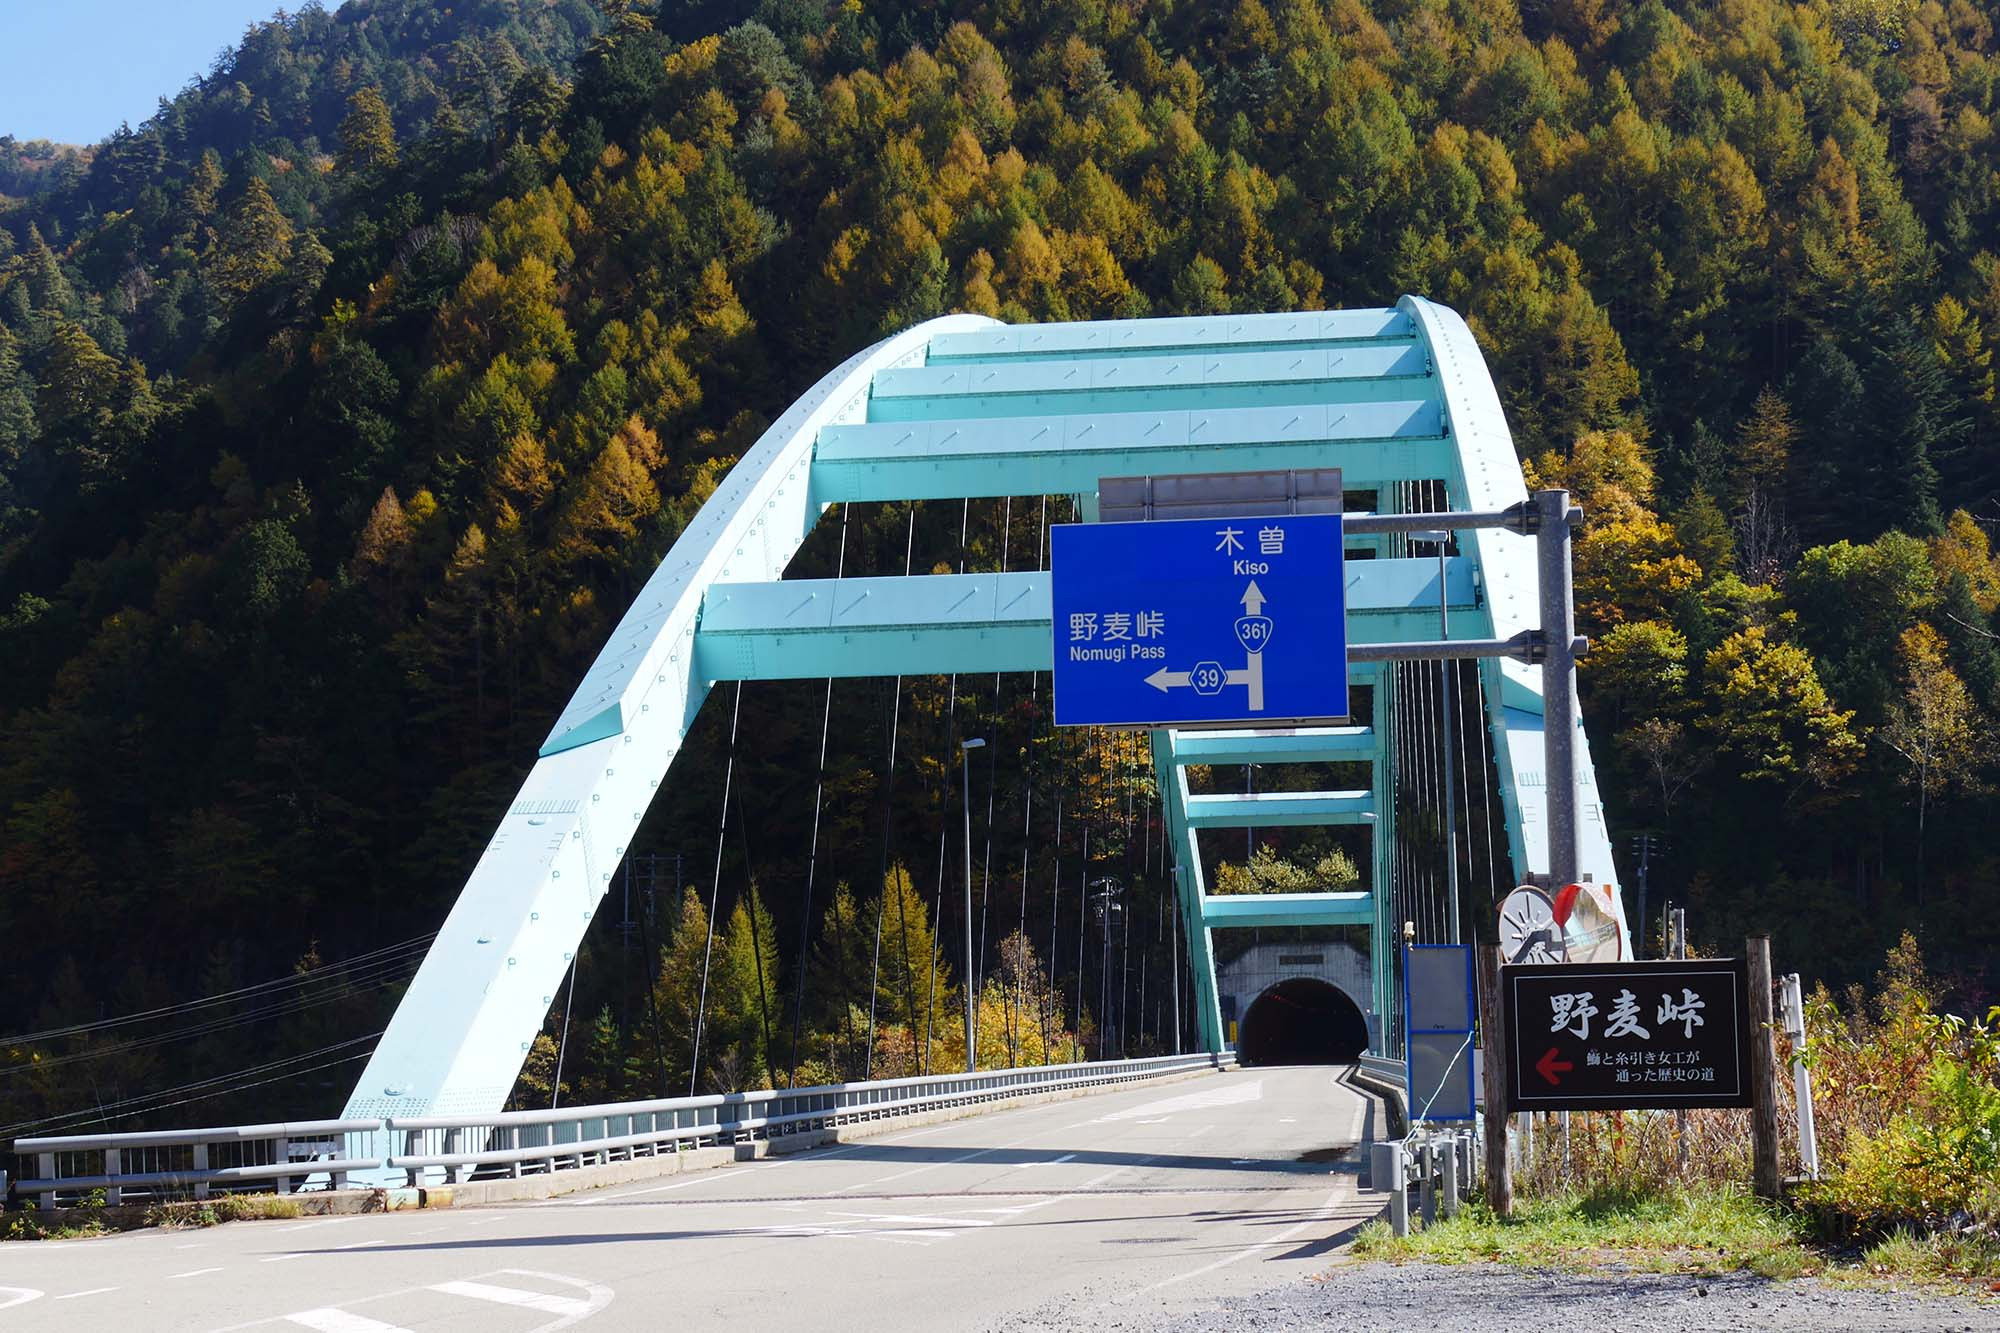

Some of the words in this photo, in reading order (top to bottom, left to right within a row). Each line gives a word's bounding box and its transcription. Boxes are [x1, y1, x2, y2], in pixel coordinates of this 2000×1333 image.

[1215, 525, 1285, 556] 木曽
[1233, 559, 1269, 575] Kiso
[1070, 610, 1165, 641] 野麦峠
[1242, 623, 1267, 640] 361
[1070, 645, 1126, 663] Nomugi
[1131, 644, 1166, 660] Pass
[1198, 670, 1220, 689] 39
[1549, 988, 1706, 1041] 野麦峠
[1615, 1067, 1715, 1082] 通った歴史の道
